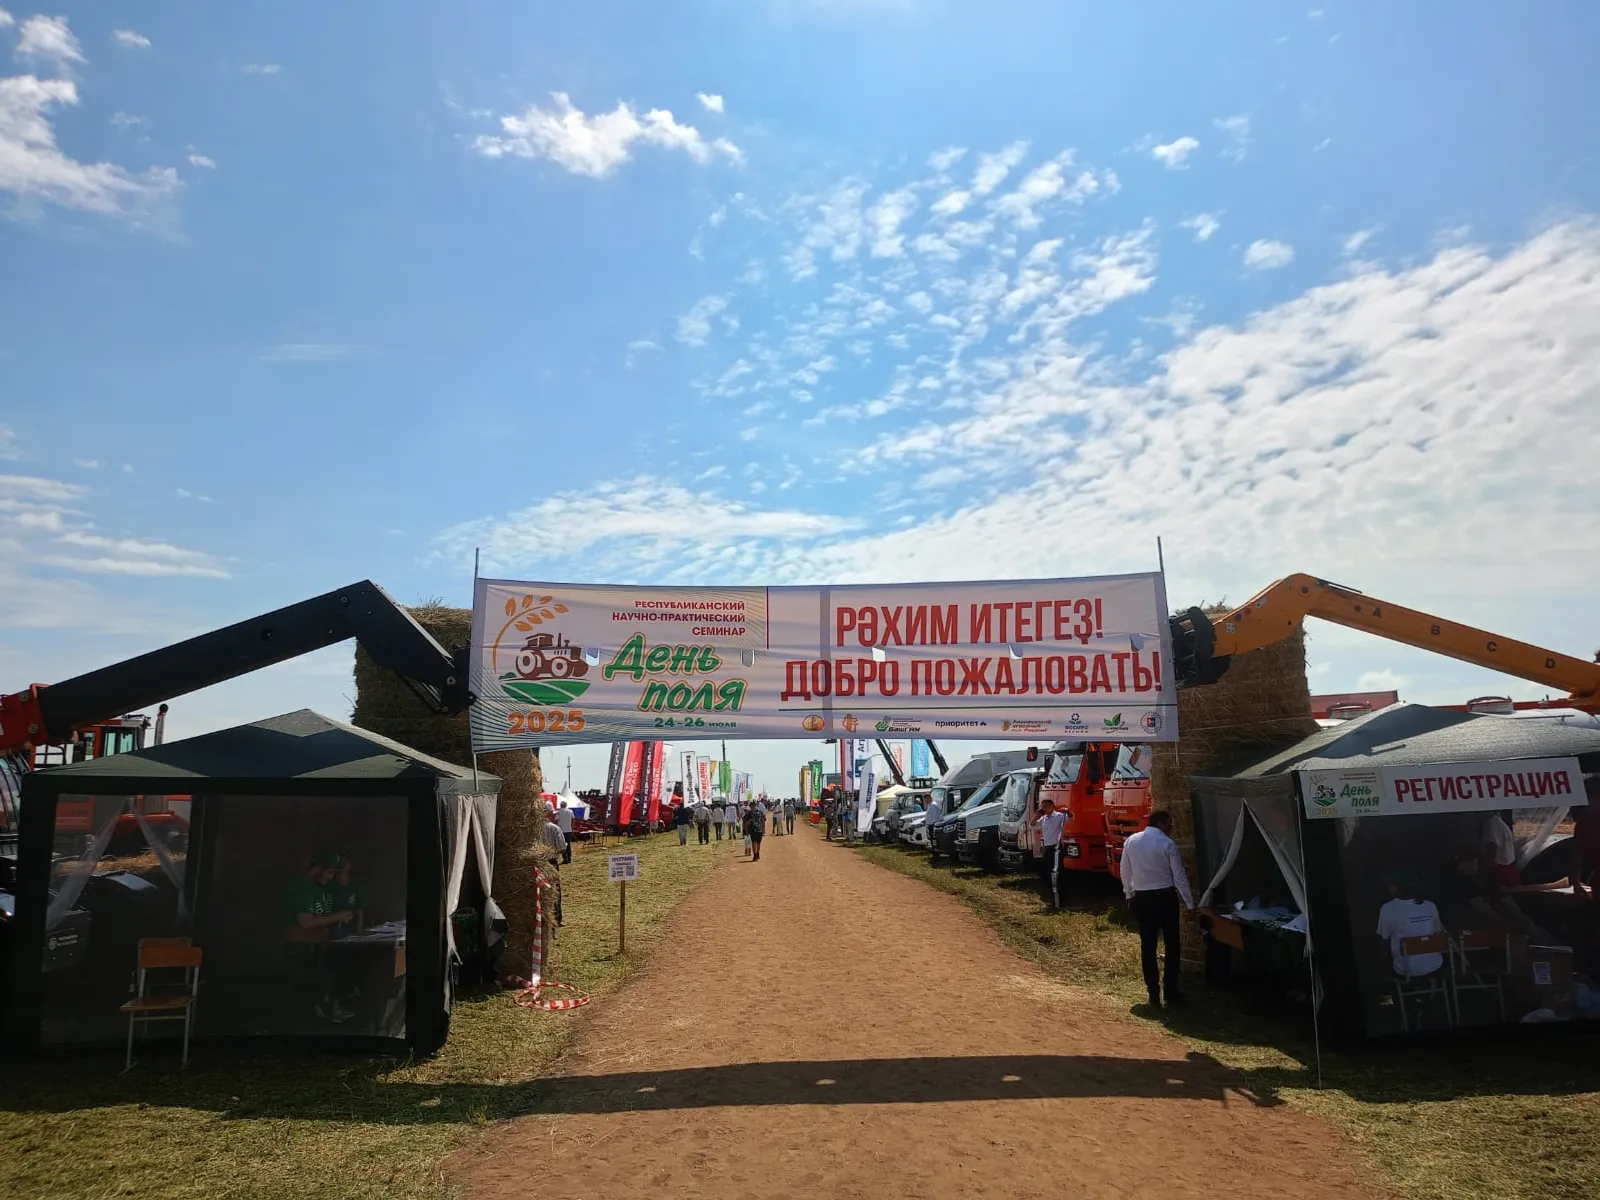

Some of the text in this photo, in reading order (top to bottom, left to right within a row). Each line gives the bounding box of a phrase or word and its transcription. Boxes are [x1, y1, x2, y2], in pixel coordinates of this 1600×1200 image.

[612, 612, 745, 622] НАУЧНО-ПРАКТИЧЕСКИЙ
[635, 601, 745, 610] РЕСПУБЛИКАНСКИЙ
[692, 627, 746, 636] СЕМИНАР
[836, 599, 1103, 647] РӘХИМ ИТЕГЕҘ!
[1373, 607, 1555, 669] A B C D
[603, 633, 721, 681] День
[781, 652, 1161, 701] ДОБРО ПОЖАЛОВАТЬ!
[639, 679, 747, 712] поля
[508, 710, 586, 734] 2025
[1340, 784, 1372, 798] День
[1394, 771, 1571, 802] РЕГИСТРАЦИЯ
[1352, 797, 1379, 808] поля
